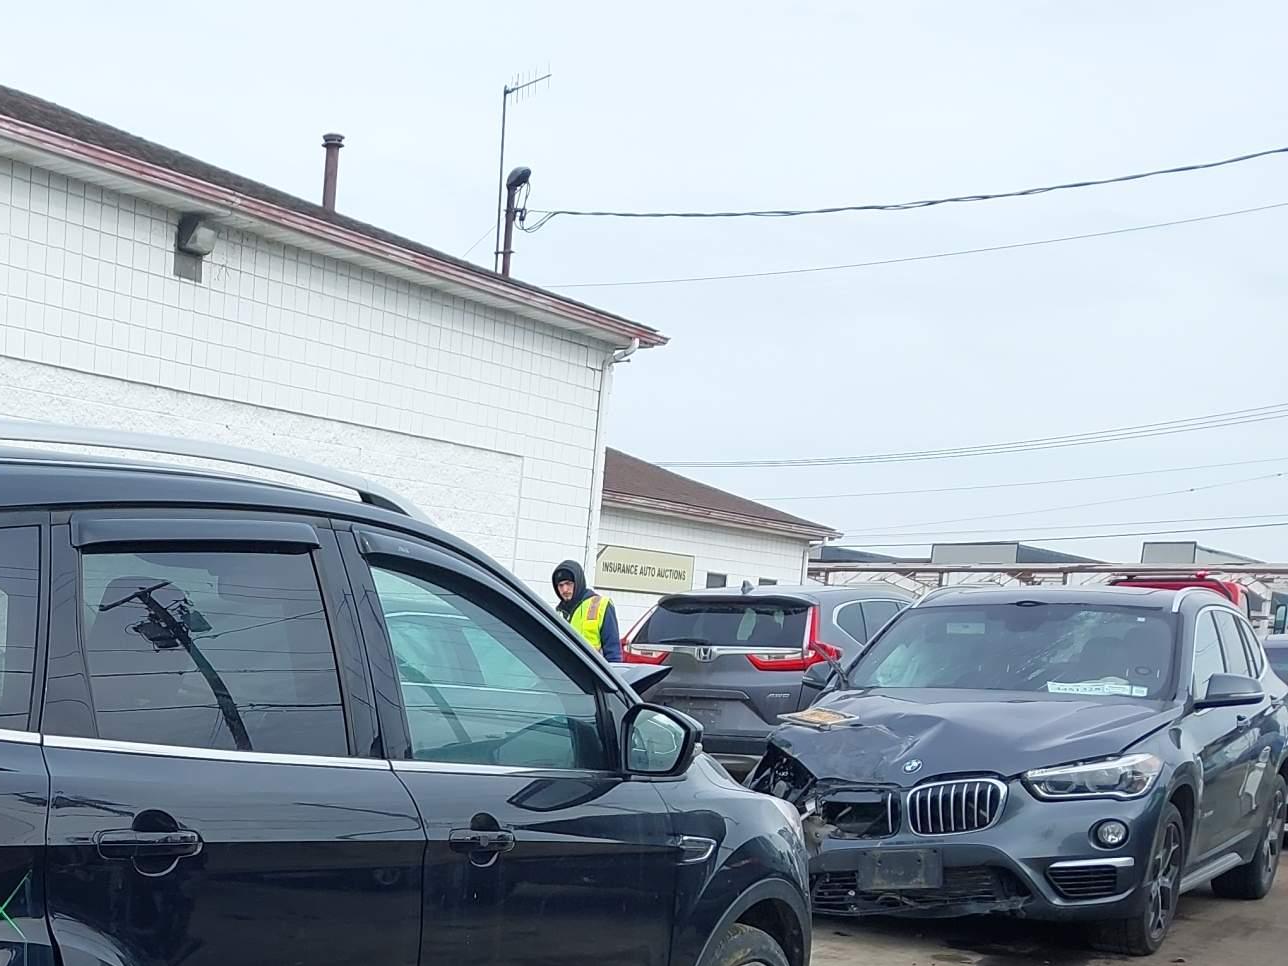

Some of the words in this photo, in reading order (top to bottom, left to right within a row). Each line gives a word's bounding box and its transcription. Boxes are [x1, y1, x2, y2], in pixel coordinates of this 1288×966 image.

[602, 562, 638, 575] INSURANCE
[639, 566, 656, 577] AUTO
[657, 568, 686, 580] AUCTIONS
